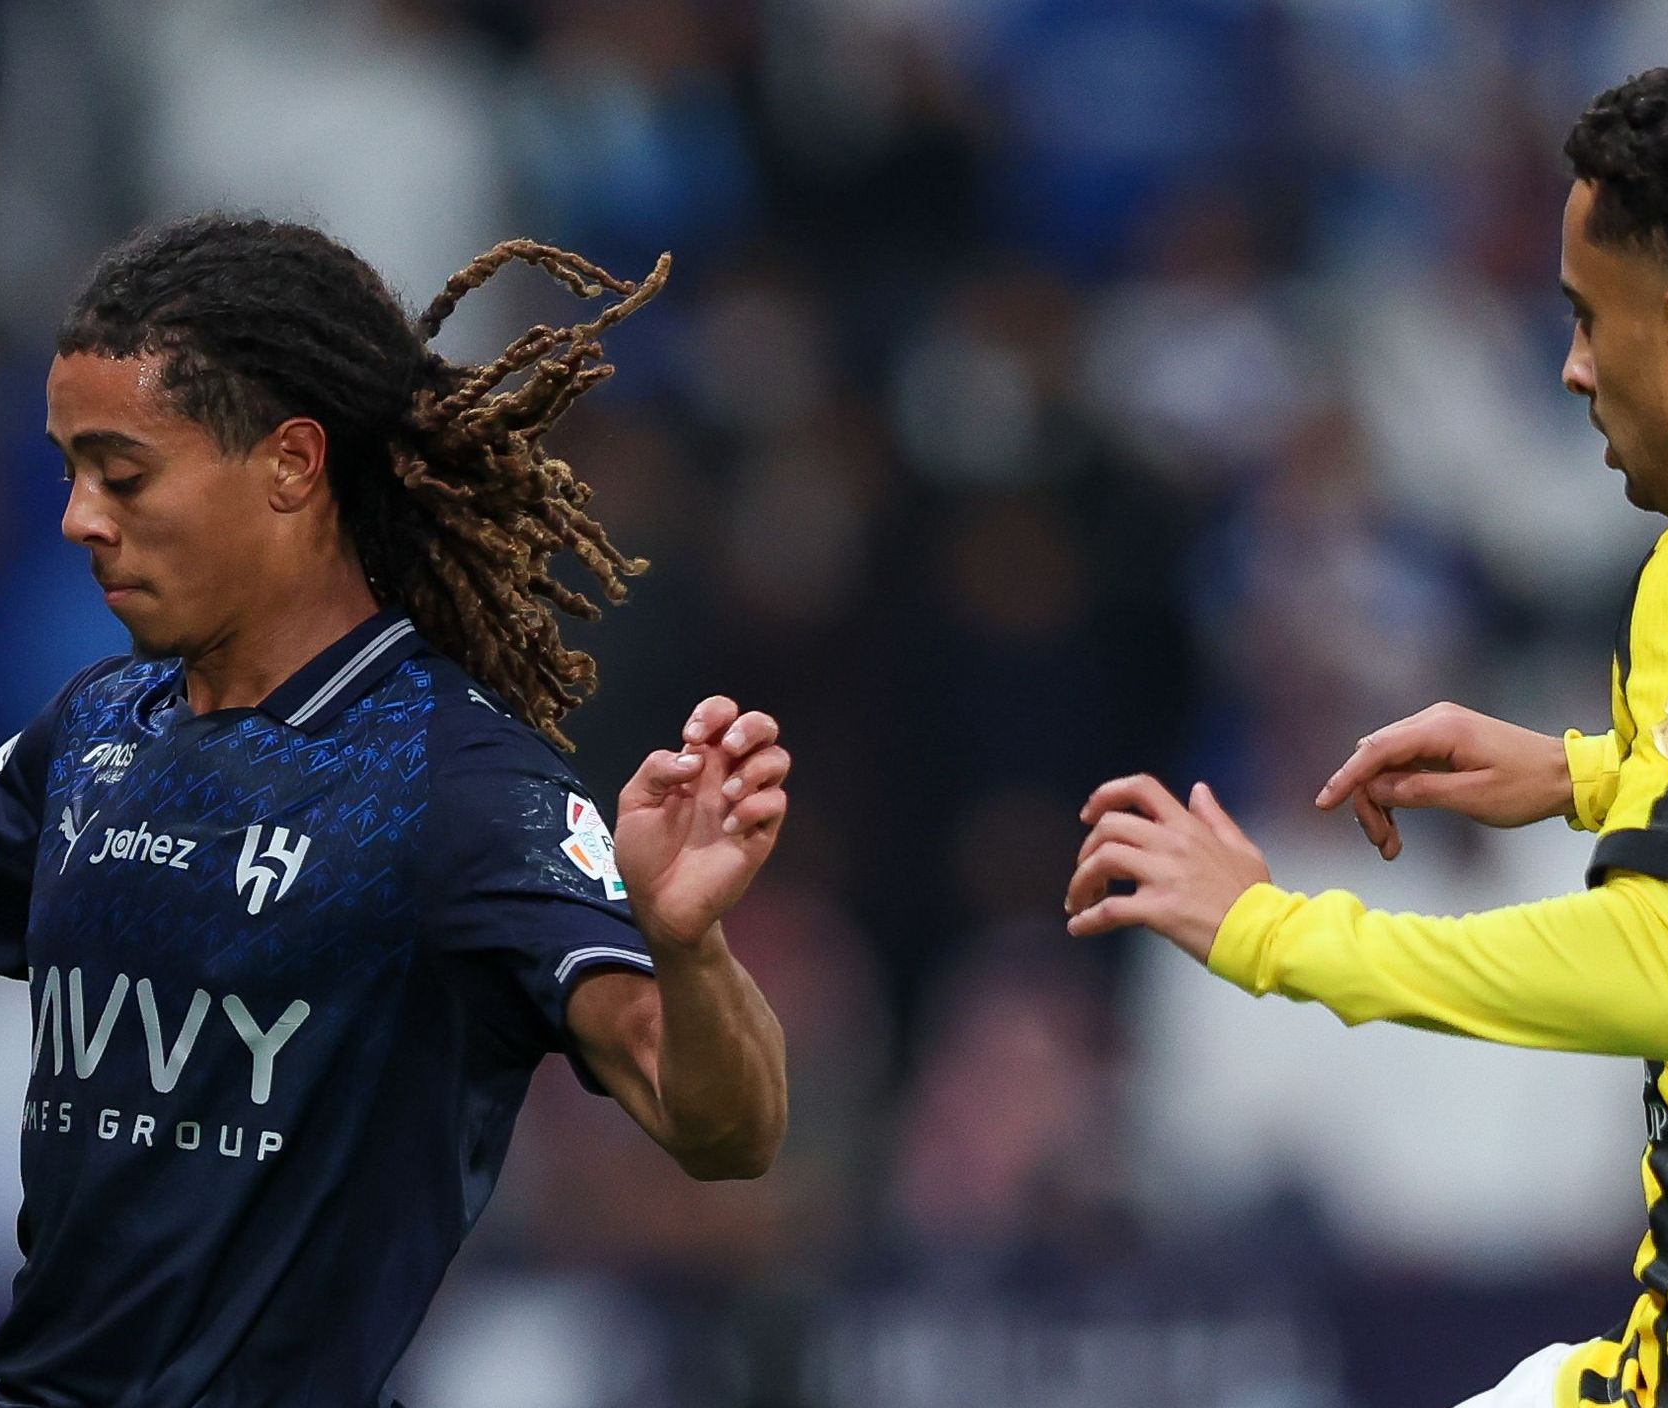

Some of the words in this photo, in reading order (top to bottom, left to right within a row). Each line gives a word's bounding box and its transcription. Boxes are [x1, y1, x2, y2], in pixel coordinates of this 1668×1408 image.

[89, 821, 197, 870] jahez
[29, 965, 311, 1105] AVVY
[22, 1101, 72, 1133] MES
[98, 1108, 283, 1162] GROUP
